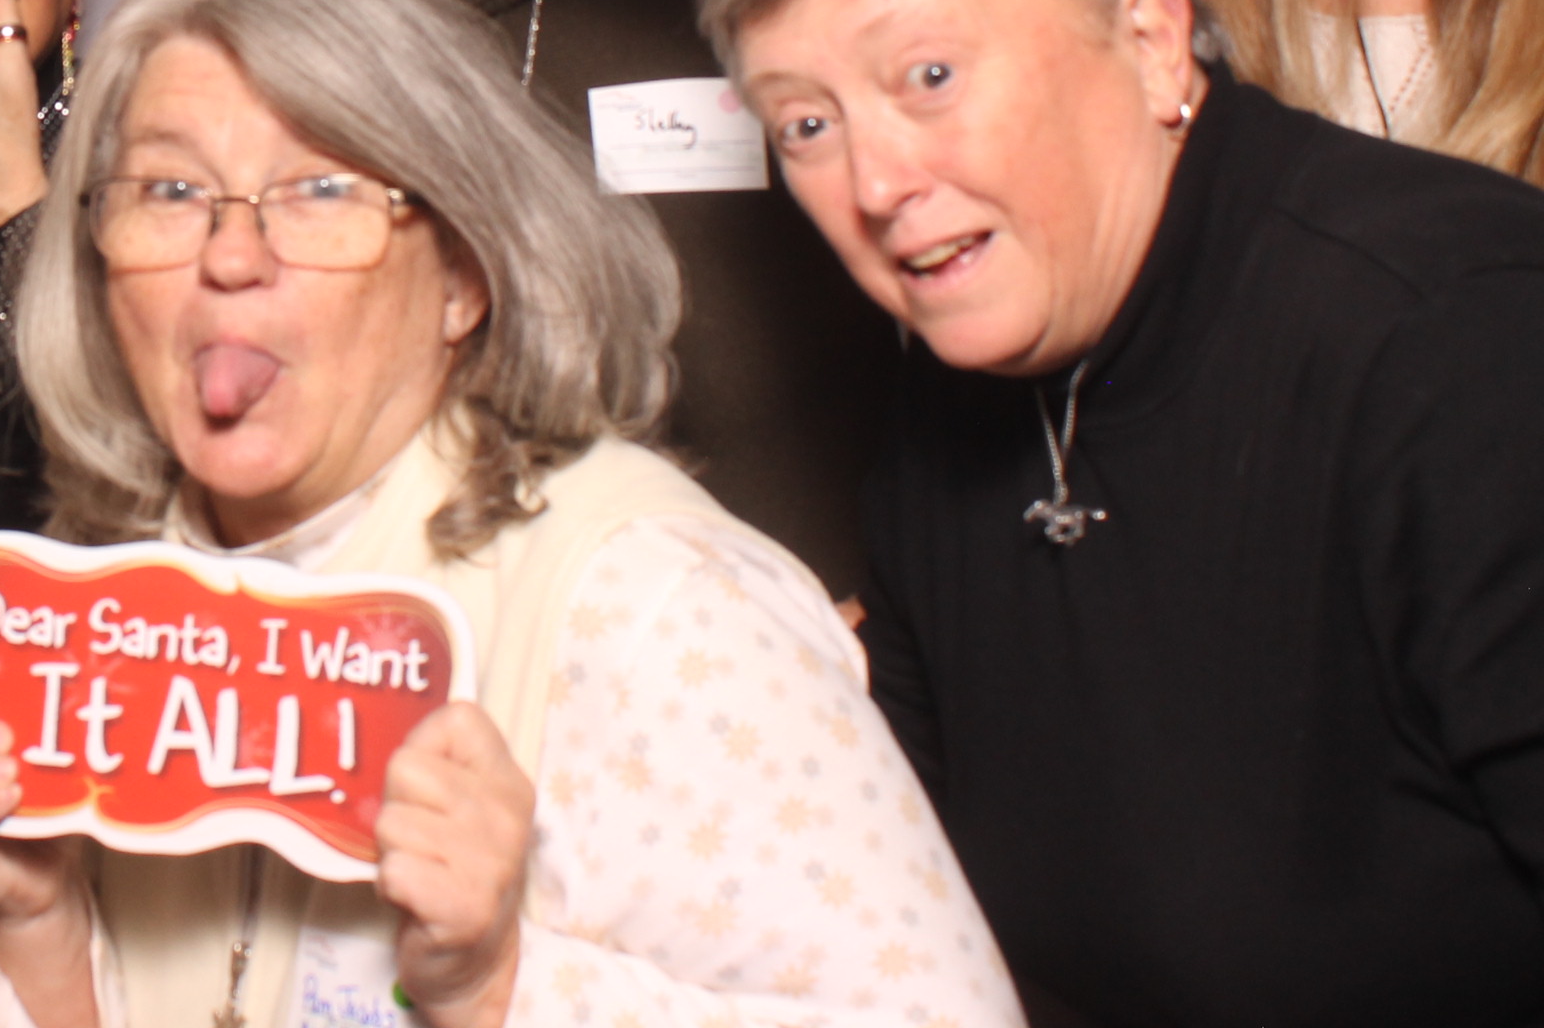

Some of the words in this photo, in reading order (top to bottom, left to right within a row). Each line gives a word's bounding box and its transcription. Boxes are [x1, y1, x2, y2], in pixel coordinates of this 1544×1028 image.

[88, 597, 242, 676] Santa,
[256, 617, 289, 676] I
[300, 626, 430, 693] Want
[21, 662, 125, 775] It
[146, 675, 357, 805] ALL!
